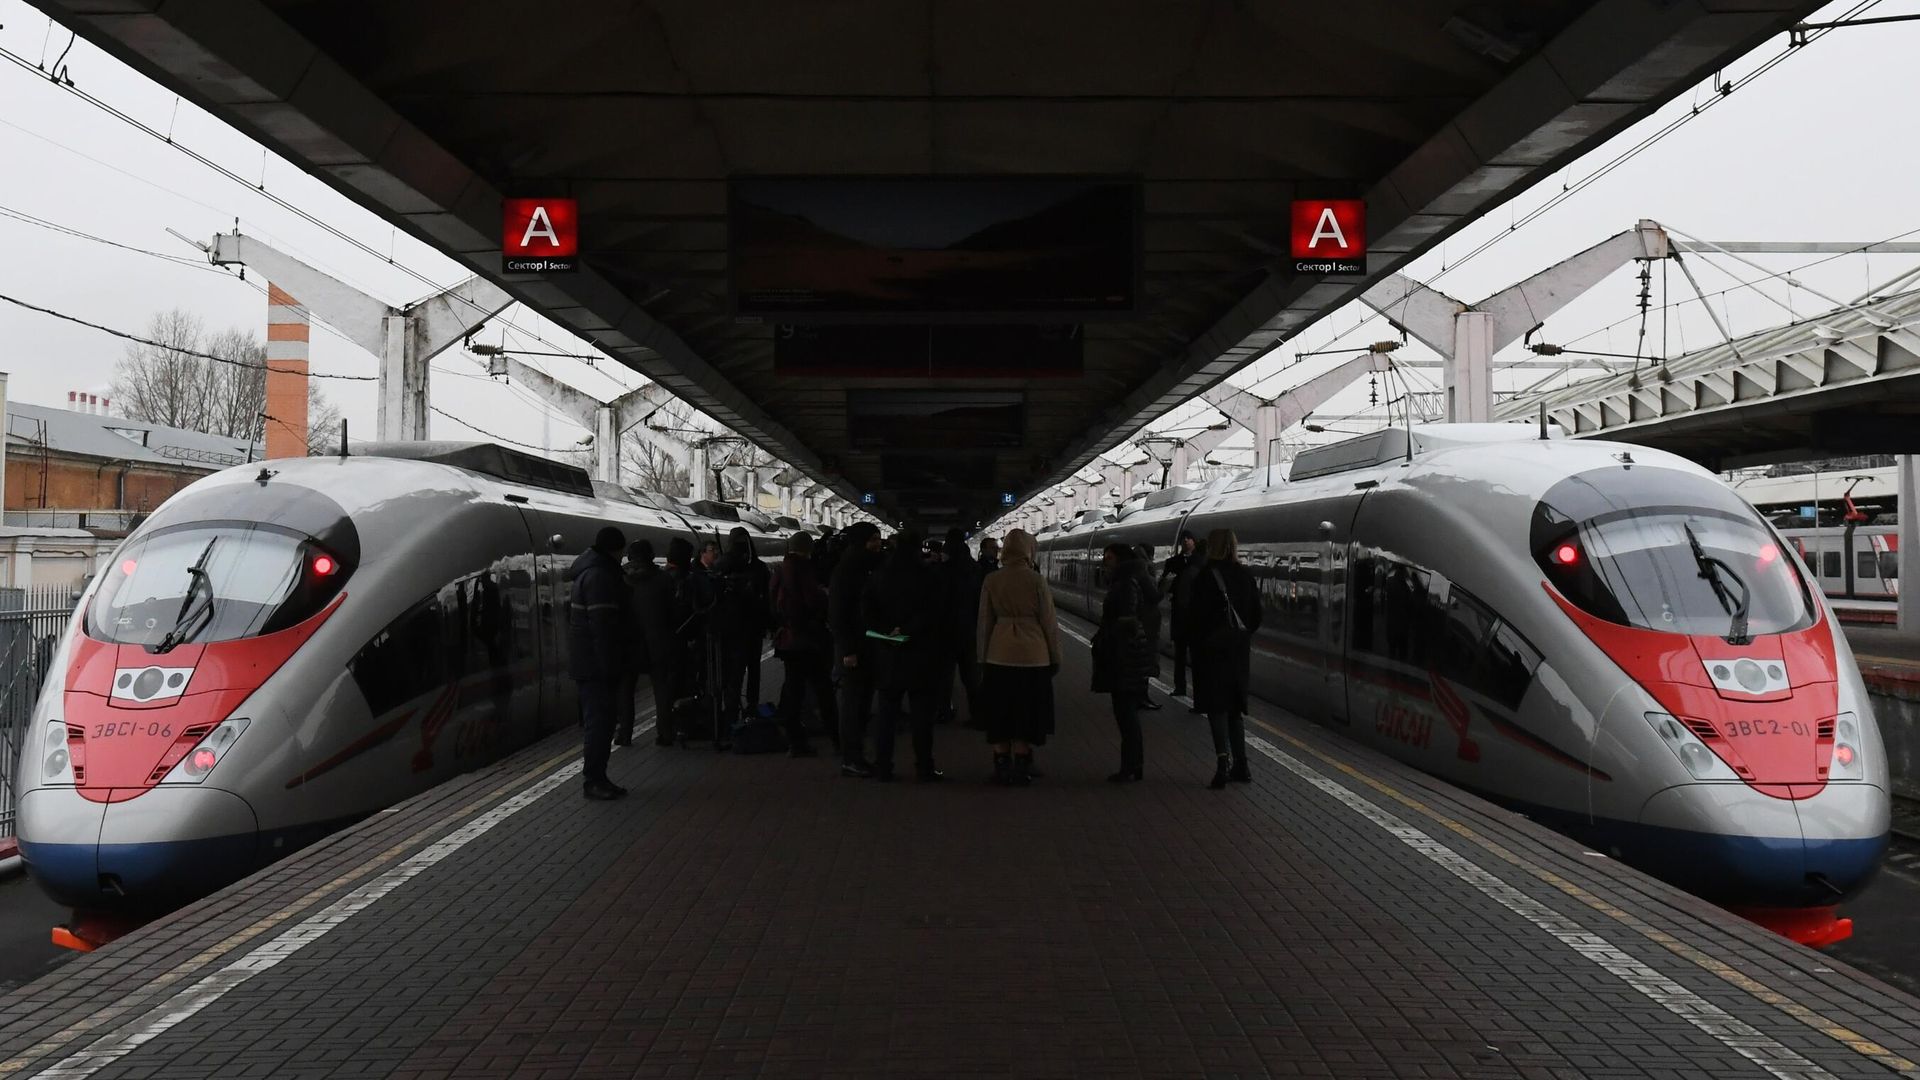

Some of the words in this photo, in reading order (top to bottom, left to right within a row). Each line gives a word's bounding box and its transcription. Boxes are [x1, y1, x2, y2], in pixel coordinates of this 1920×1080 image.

[520, 206, 560, 247] A
[1308, 208, 1349, 249] A
[507, 261, 543, 271] Сектор
[1296, 262, 1332, 273] Сектор
